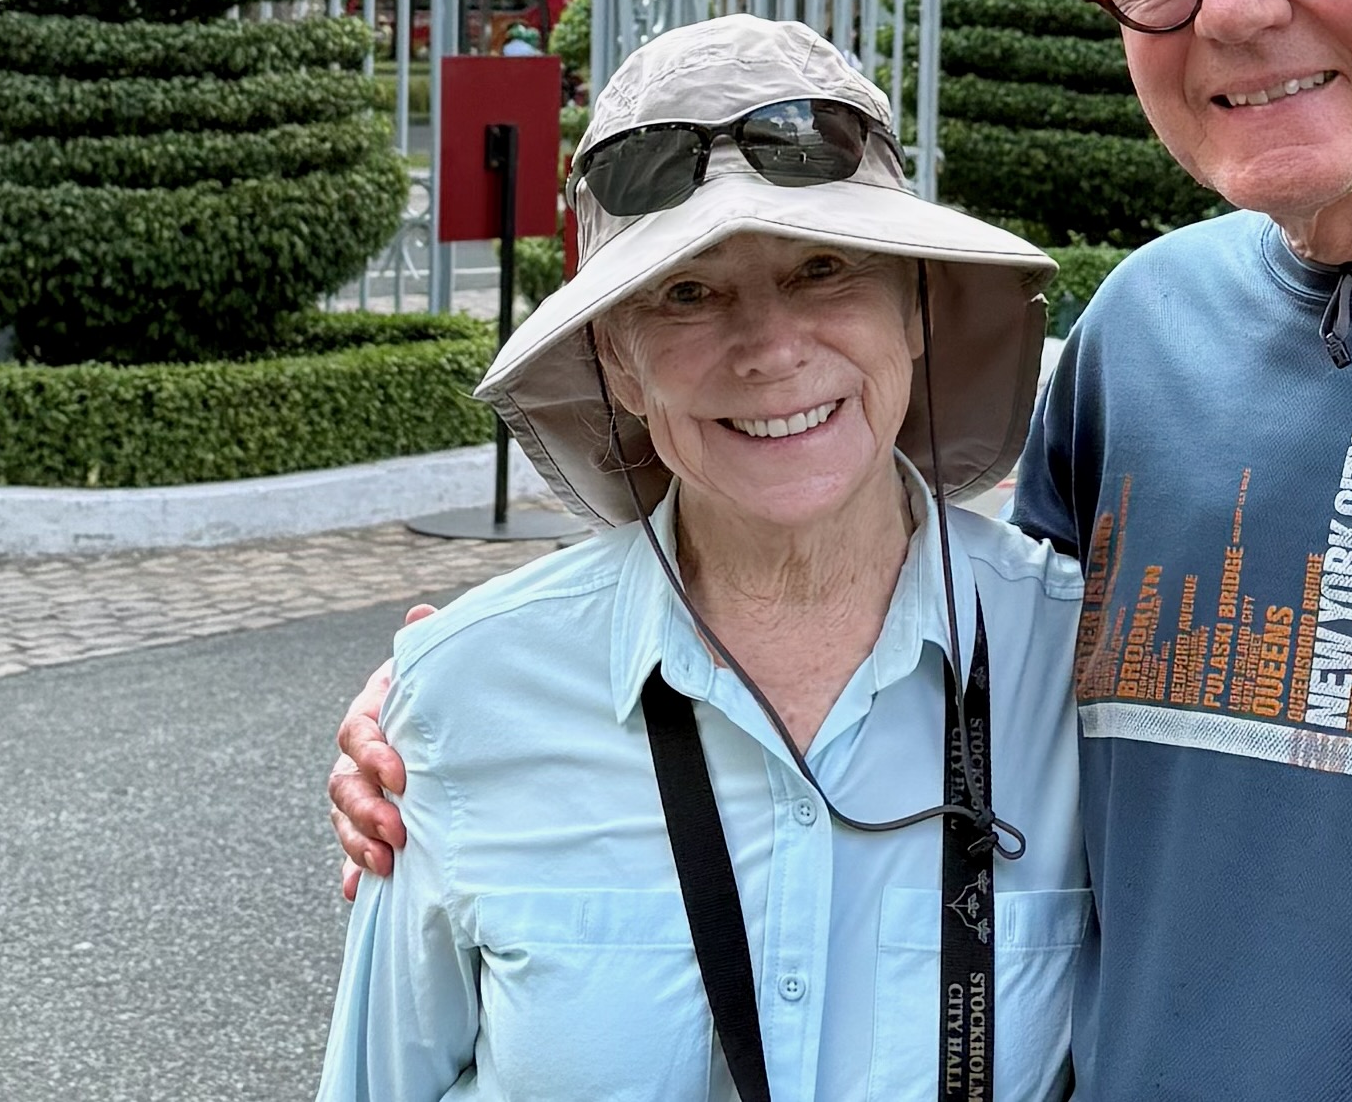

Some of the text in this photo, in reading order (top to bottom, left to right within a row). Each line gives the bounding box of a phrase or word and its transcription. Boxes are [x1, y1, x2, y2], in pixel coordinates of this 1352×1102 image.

[1117, 565, 1163, 697] BROOKLYN
[1170, 574, 1198, 703] BEDFORD AVENUE
[1218, 547, 1244, 619] BRIDGE
[1287, 553, 1324, 721] QUEENSBORO BRIDGE
[1204, 623, 1233, 708] PULASKI
[1229, 595, 1255, 711] LONG ISLAND CITY
[1246, 634, 1263, 683] STREET
[1252, 605, 1294, 717] QUEENS
[947, 983, 963, 1095] CITY HALL
[968, 972, 985, 1102] STOCKHOLM
